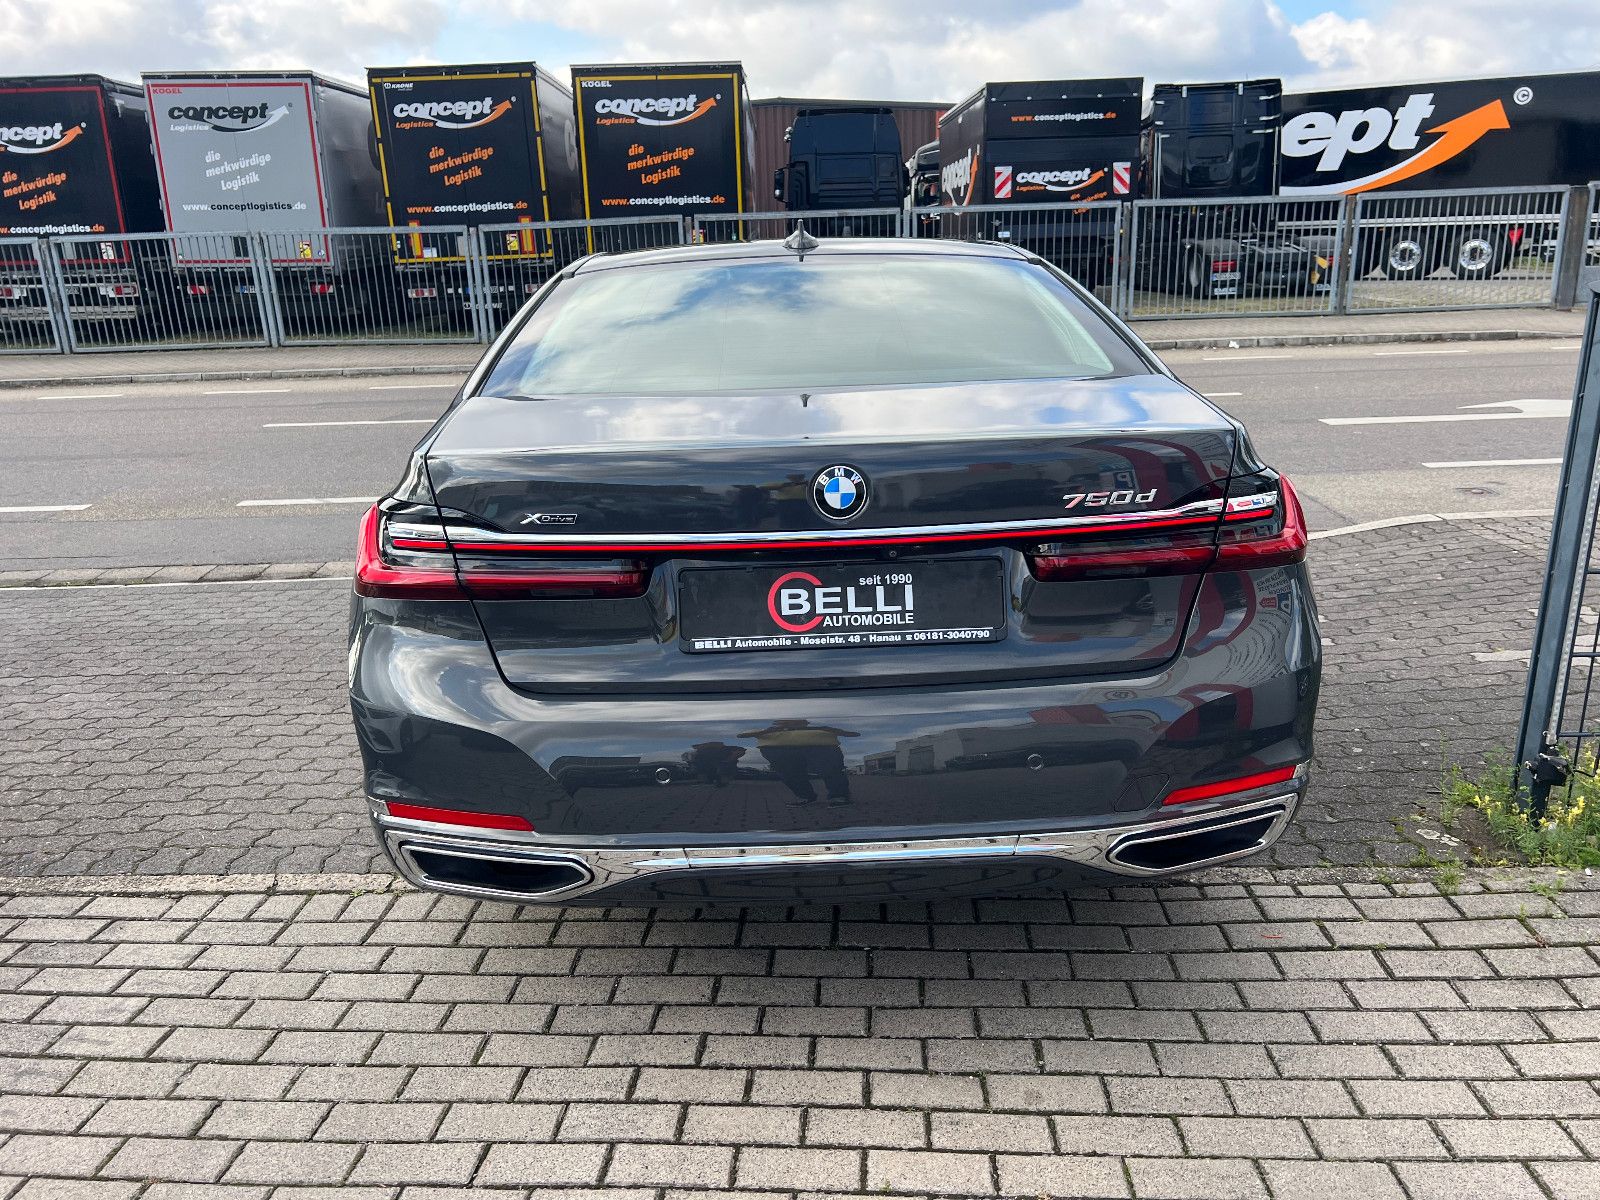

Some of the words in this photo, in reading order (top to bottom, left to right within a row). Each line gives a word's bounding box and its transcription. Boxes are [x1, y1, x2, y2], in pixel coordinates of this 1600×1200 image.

[168, 102, 269, 124] concept
[393, 96, 493, 120] concept
[594, 94, 698, 117] concept
[395, 121, 435, 130] Logistics
[596, 117, 636, 126] Logistics
[1010, 111, 1117, 123] www.conceptlogistics.de
[170, 124, 210, 132] Logistics
[205, 150, 221, 163] die
[428, 146, 445, 159] die
[627, 146, 695, 171] merkwürdige
[628, 143, 645, 157] die
[205, 153, 272, 178] merkwürdige
[429, 147, 494, 174] merkwürdige
[2, 171, 18, 183] die
[220, 171, 260, 191] Logistik
[444, 165, 483, 186] Logistik
[641, 165, 682, 185] Logistik
[1016, 167, 1091, 184] concept
[3, 172, 67, 198] merkwürdige
[18, 190, 57, 210] Logistik
[182, 201, 307, 212] www.conceptlogistics.de
[407, 201, 529, 214] www.conceptlogistics.de
[601, 194, 726, 206] www.conceptlogistics.de
[818, 467, 862, 486] BMW
[1062, 488, 1158, 509] 750d
[859, 574, 881, 585] seit
[884, 573, 913, 585] 1990
[780, 584, 914, 616] BELLI
[822, 612, 915, 628] AUTOMOBILE
[694, 640, 732, 650] BELLI
[734, 636, 792, 648] Automobile
[800, 635, 846, 646] Moselstr.
[847, 634, 861, 643] 48
[869, 633, 902, 643] Hanau
[913, 629, 990, 641] 06181-3040790
